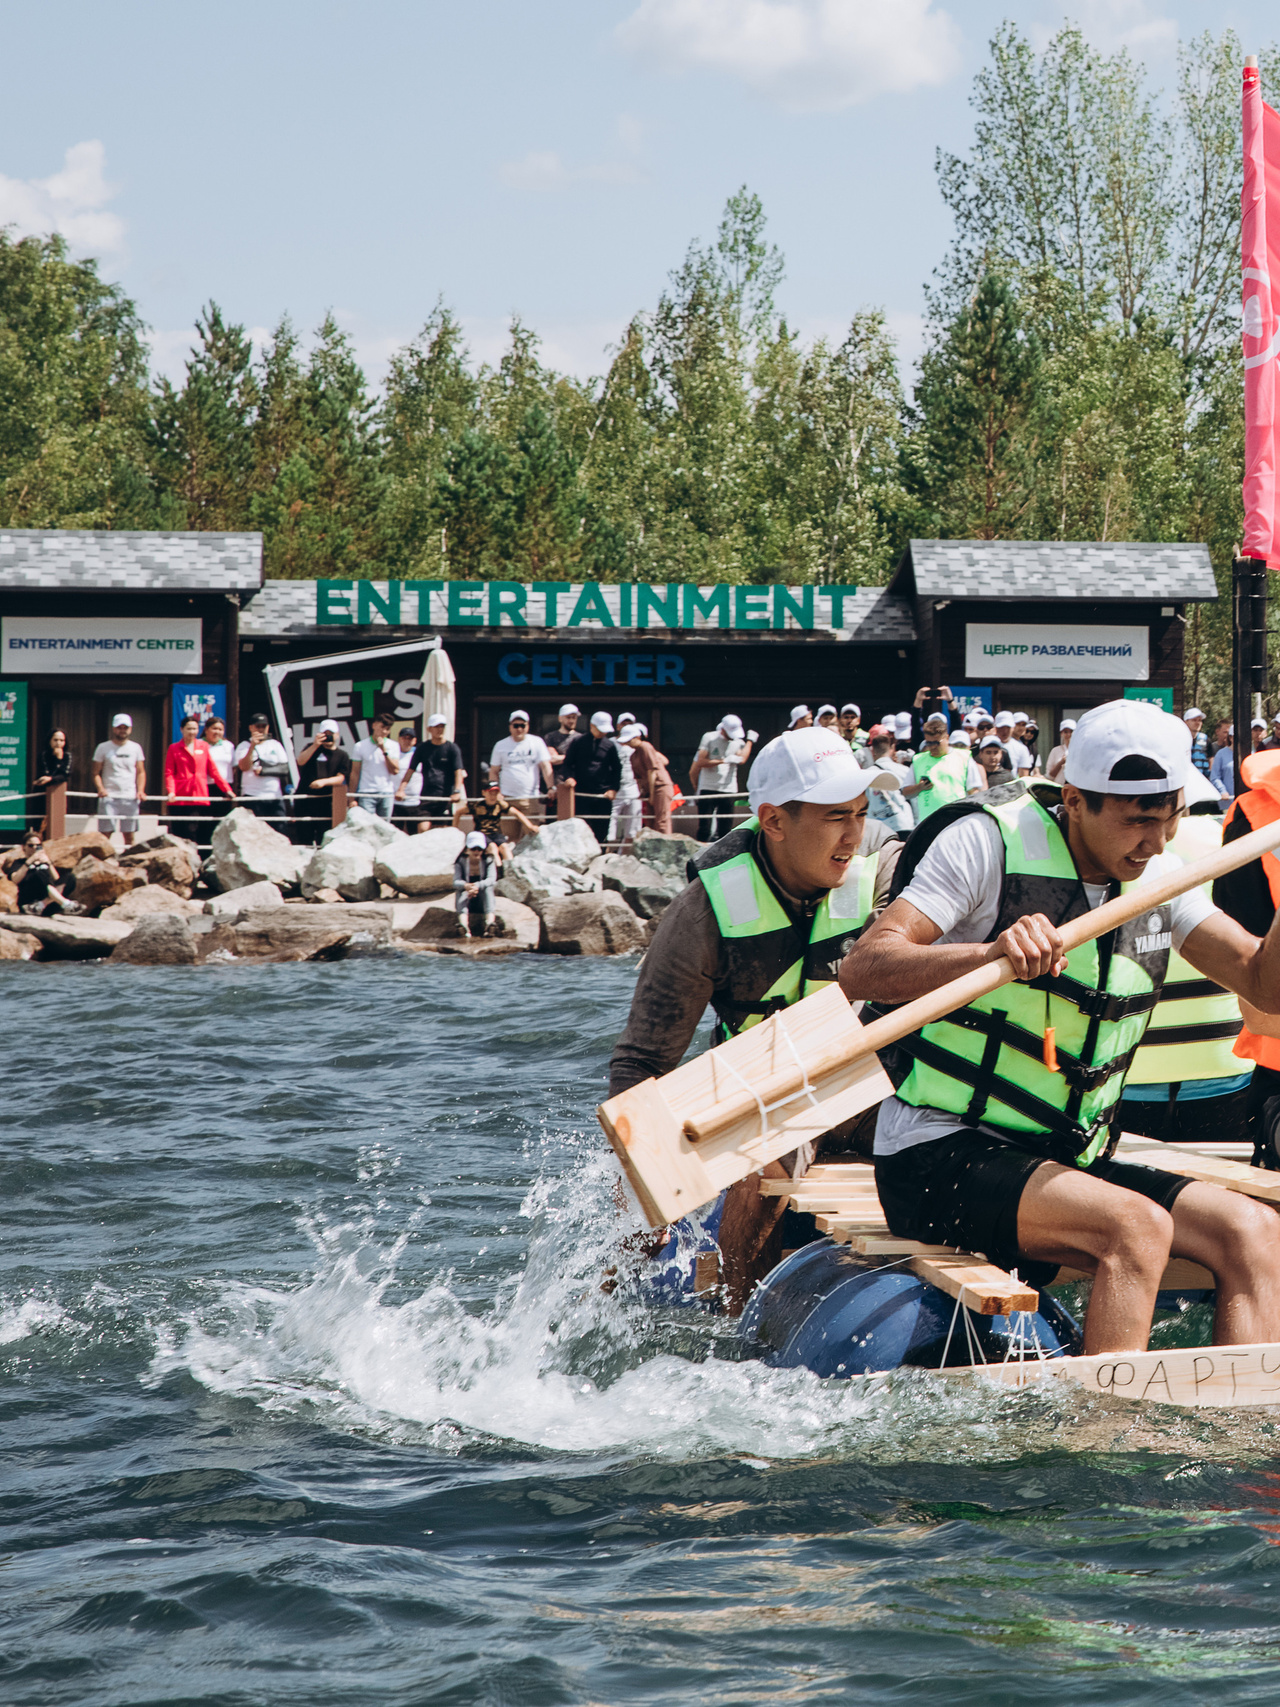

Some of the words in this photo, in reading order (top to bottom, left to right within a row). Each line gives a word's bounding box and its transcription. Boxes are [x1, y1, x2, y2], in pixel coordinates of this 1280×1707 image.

[316, 578, 857, 631] ENTERTAINMENT
[8, 638, 133, 650] ENTERTAINMENT
[136, 638, 195, 650] CENTER
[983, 644, 1029, 657] ЦЕНТР
[1031, 643, 1132, 657] РАЗВЛЕЧЕНИЙ
[498, 652, 687, 687] CENTER
[300, 678, 425, 719] LET'S
